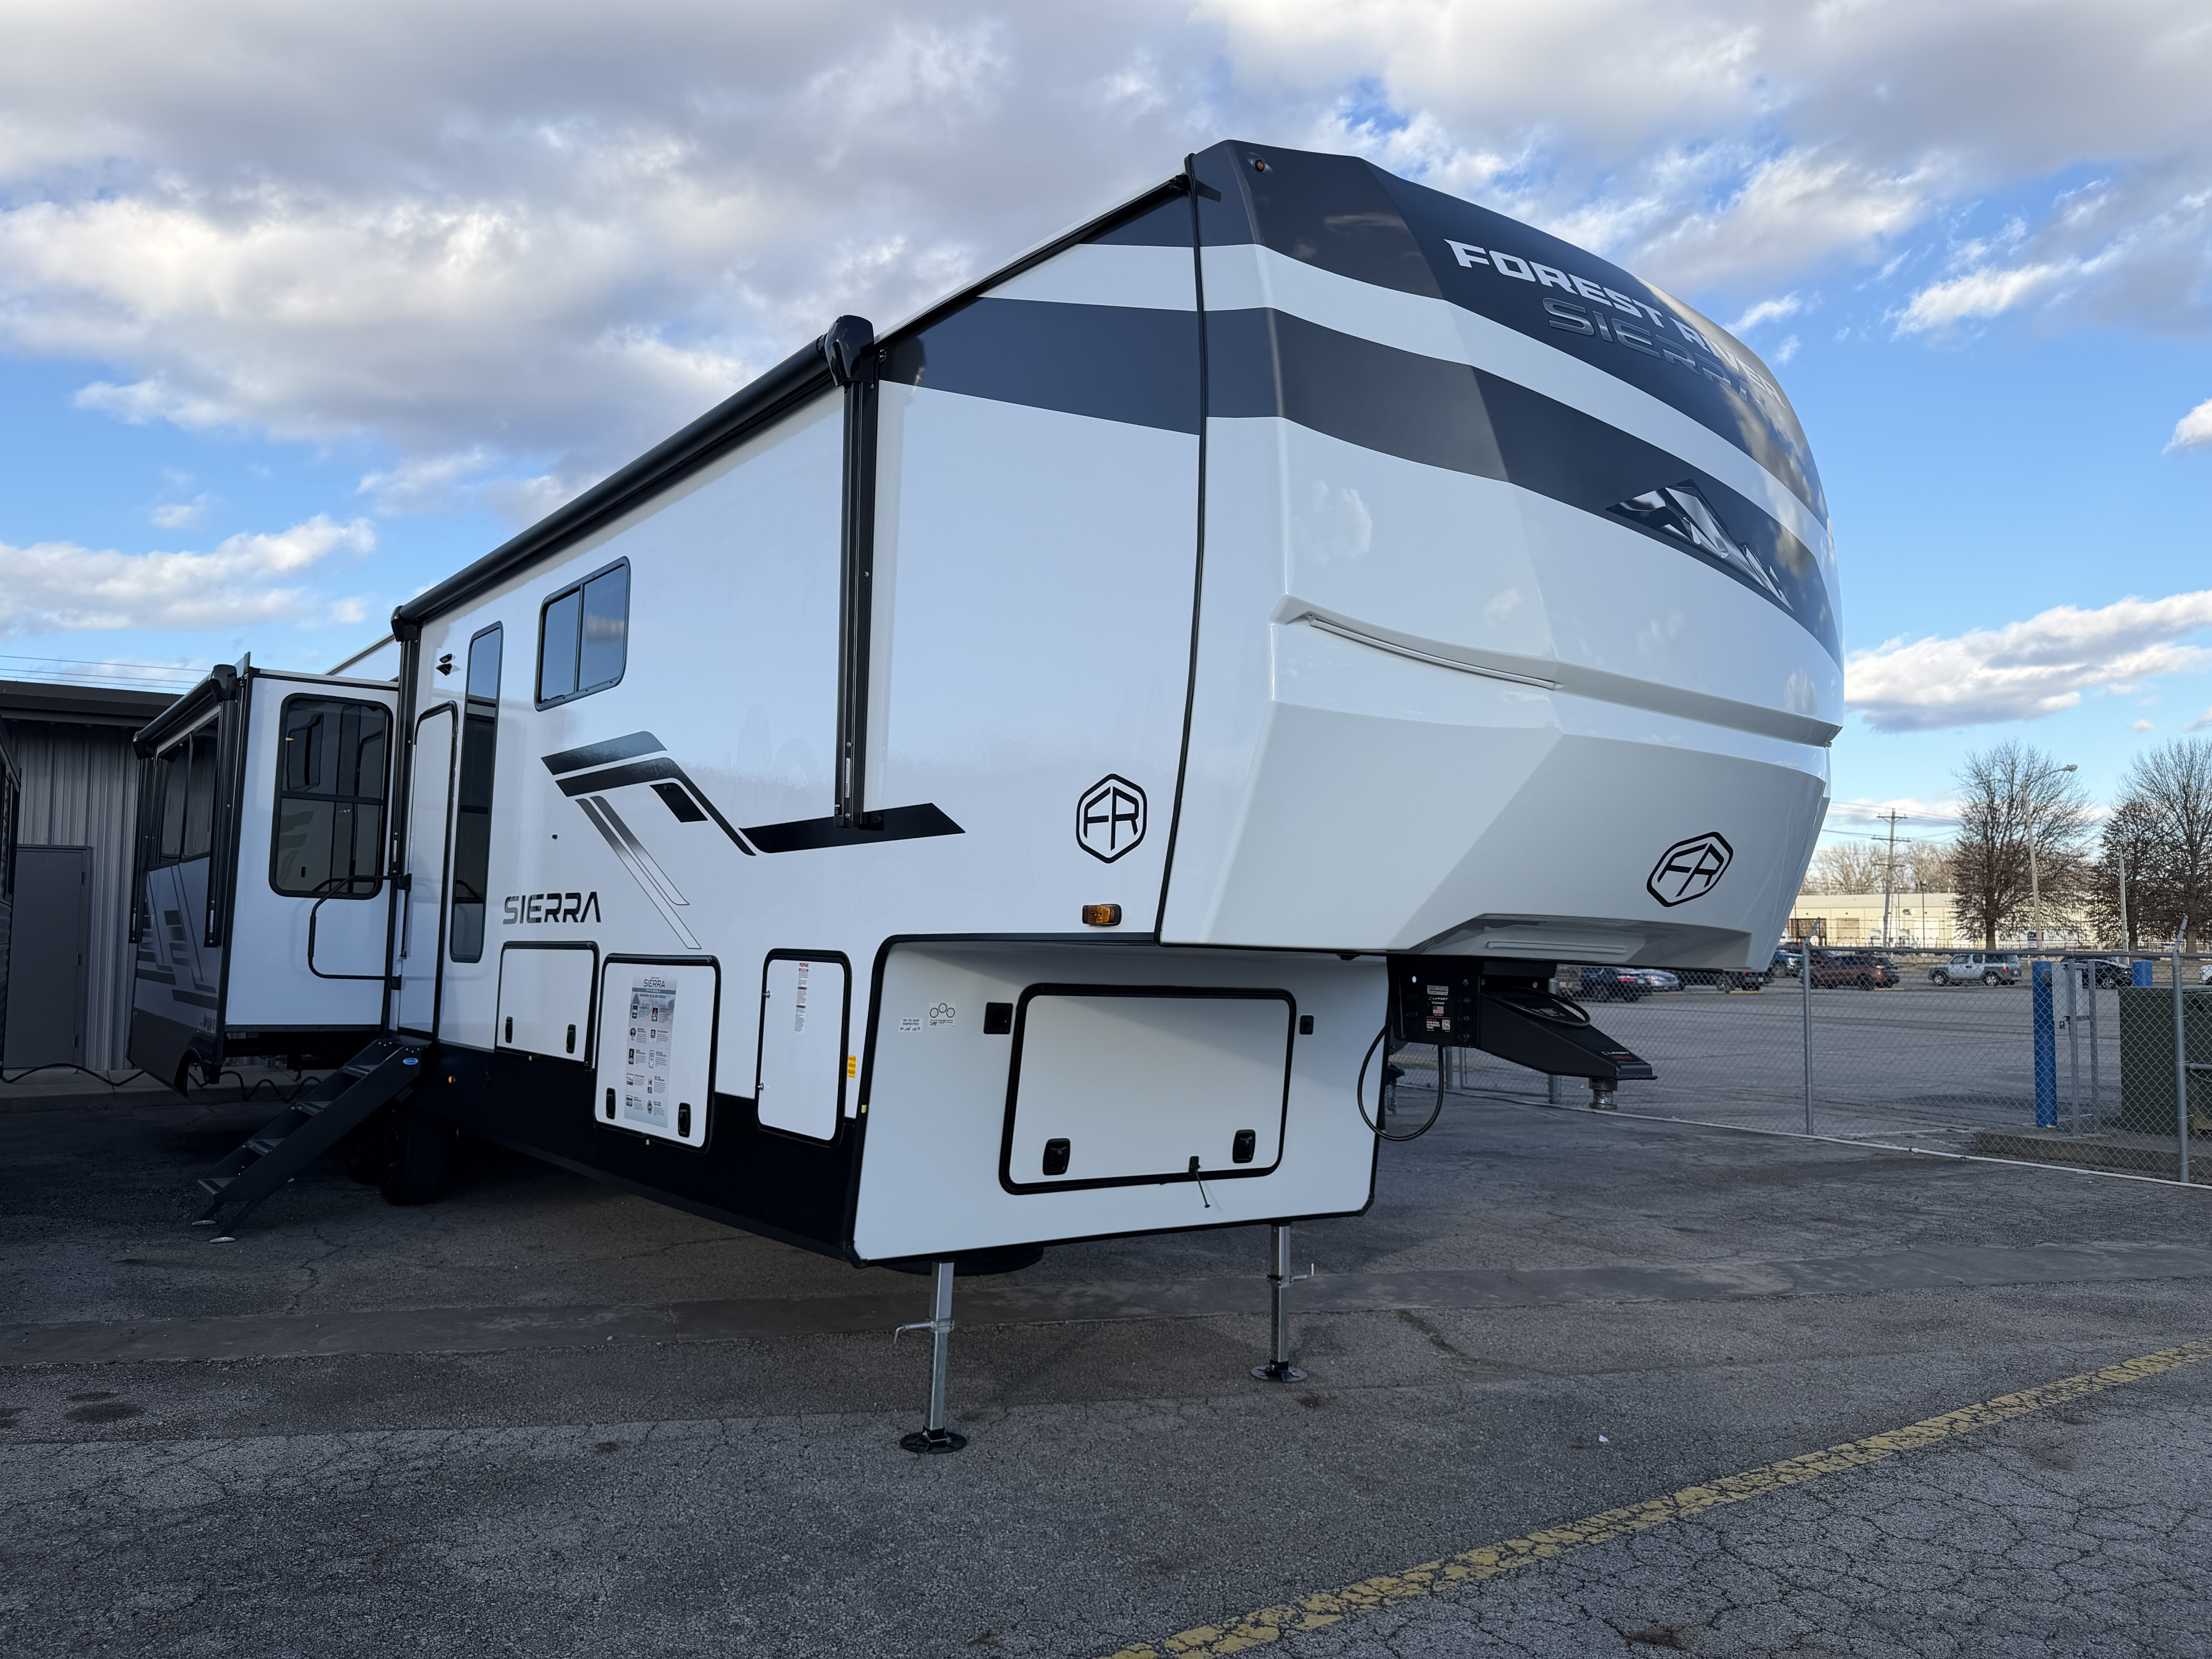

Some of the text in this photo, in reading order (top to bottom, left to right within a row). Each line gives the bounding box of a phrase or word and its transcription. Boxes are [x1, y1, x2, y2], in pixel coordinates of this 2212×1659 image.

[1443, 238, 1787, 409] FOREST RIVER
[1542, 297, 1771, 422] SIERRA
[503, 891, 601, 924] SIERRA
[643, 979, 665, 988] SIERRA
